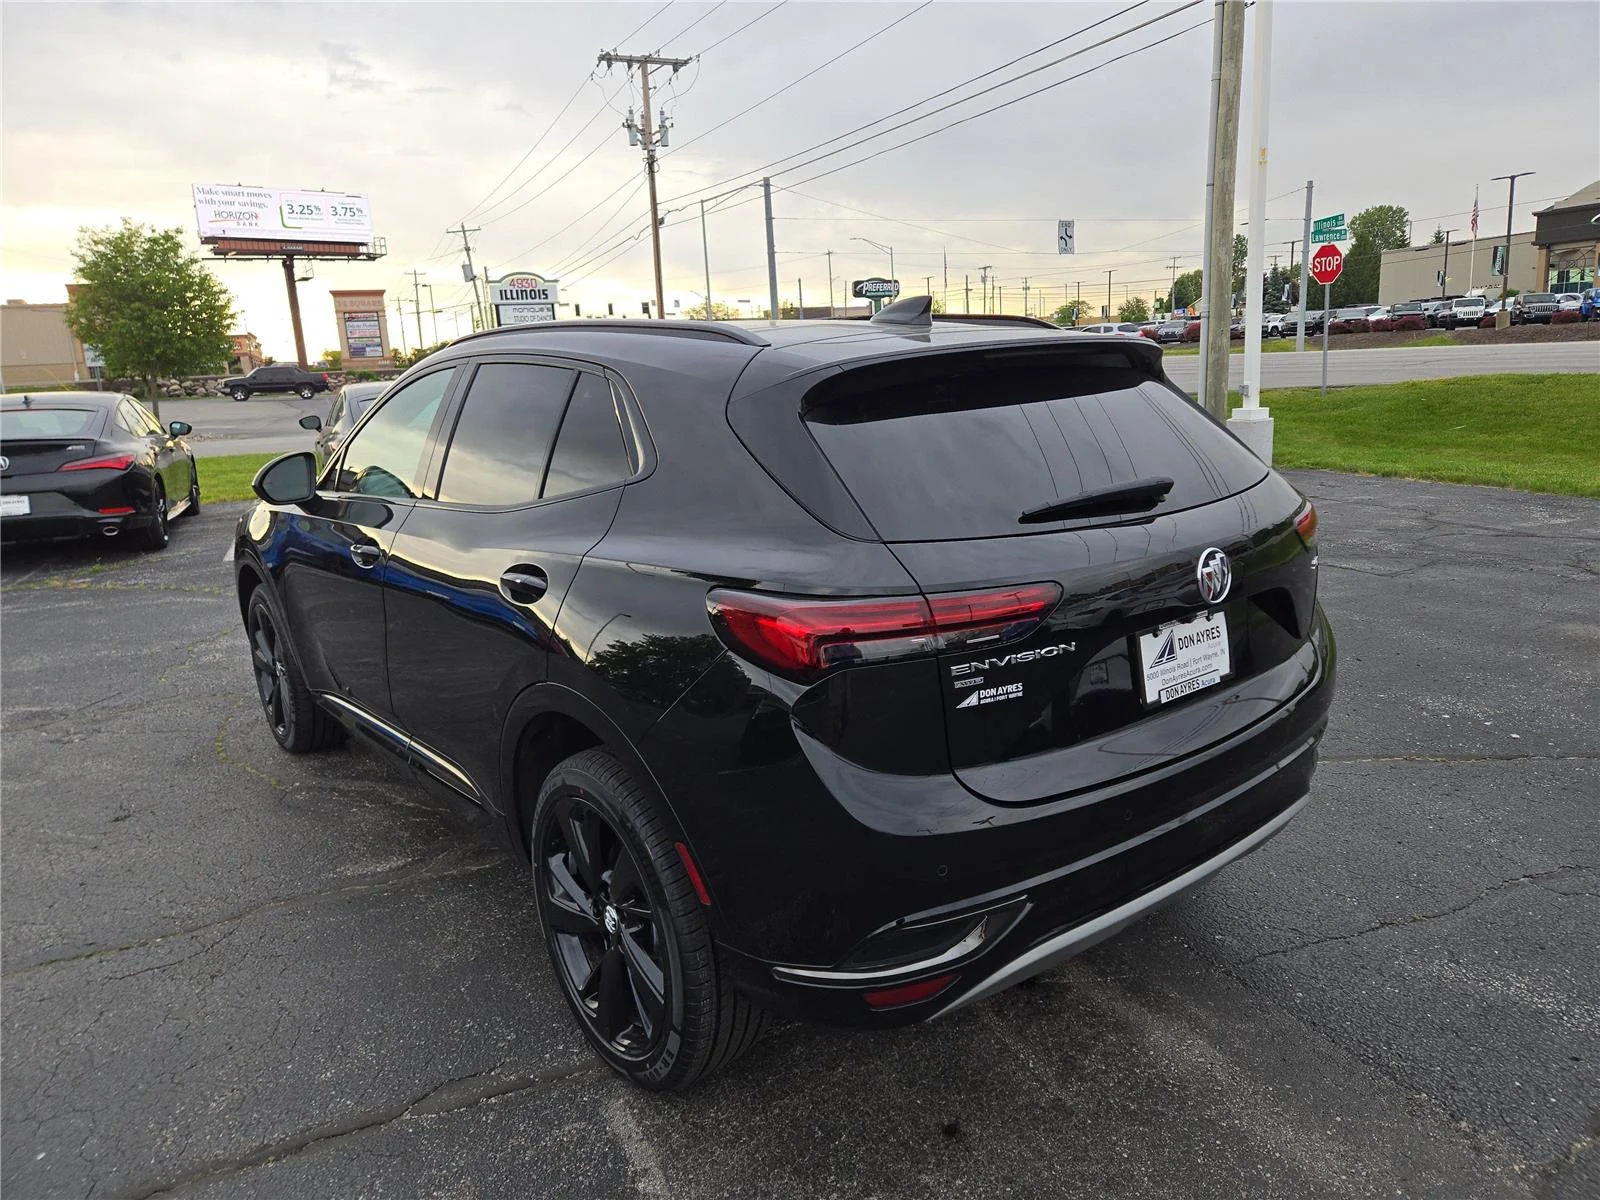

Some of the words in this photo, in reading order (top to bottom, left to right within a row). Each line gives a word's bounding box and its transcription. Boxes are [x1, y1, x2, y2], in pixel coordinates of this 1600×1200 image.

[196, 187, 220, 196] Make
[221, 189, 245, 198] smart
[246, 191, 272, 199] moves
[198, 197, 217, 205] with
[213, 210, 258, 221] HORIZON
[1312, 232, 1340, 242] Lawrence
[1314, 256, 1340, 272] STOP
[509, 278, 538, 289] 4930
[862, 281, 899, 295] PREFERRD
[499, 288, 549, 301] ILLINOIS
[1178, 635, 1195, 650] DON
[1196, 626, 1221, 645] AYRES
[951, 642, 1075, 676] ENVISION
[1147, 672, 1159, 681] 5000
[1160, 665, 1176, 675] Illinois
[1177, 661, 1189, 671] Road
[1193, 655, 1203, 665] Fort
[1161, 663, 1213, 686] DonAyresAcura.com
[980, 688, 996, 698] DON
[997, 682, 1023, 695] AYRES
[1166, 689, 1180, 700] DON
[1180, 679, 1200, 694] AYRES
[1201, 677, 1215, 686] Acura
